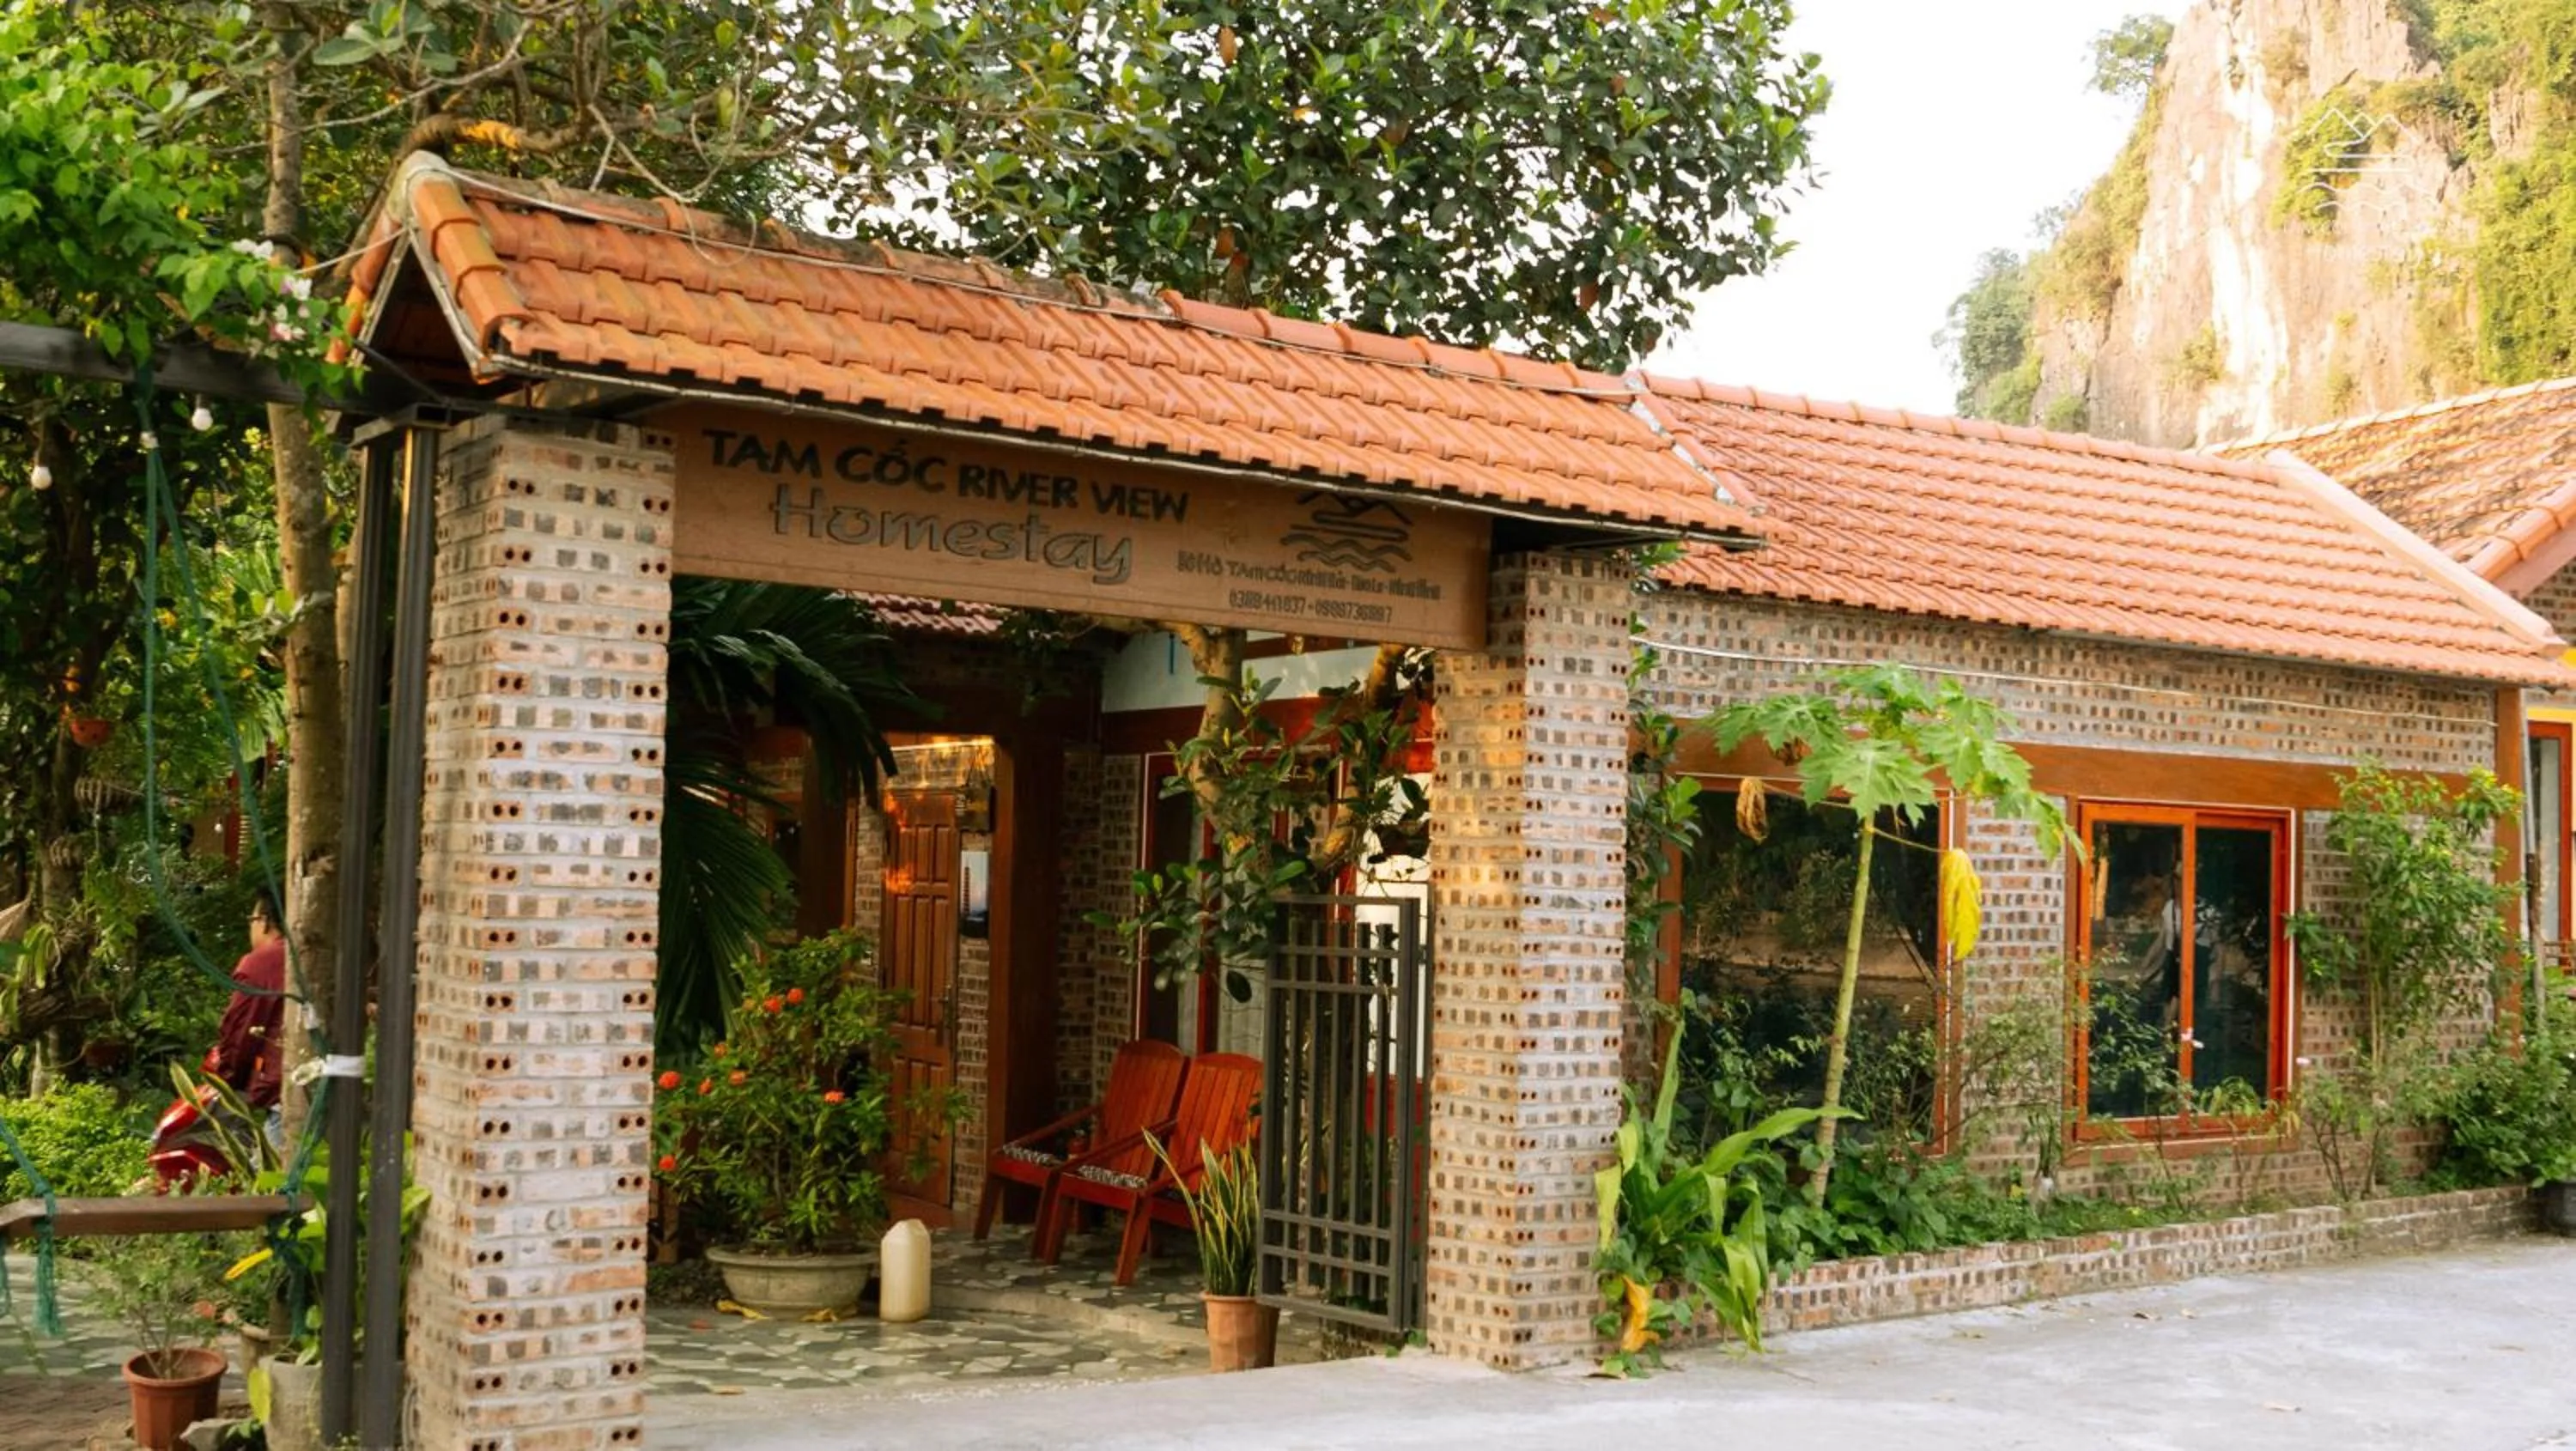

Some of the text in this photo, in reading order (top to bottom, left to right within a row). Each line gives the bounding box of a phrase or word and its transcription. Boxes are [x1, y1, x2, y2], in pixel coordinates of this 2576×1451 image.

[702, 428, 1190, 523] TAM CỐC RIVER VIEW
[769, 483, 1133, 586] Homestay
